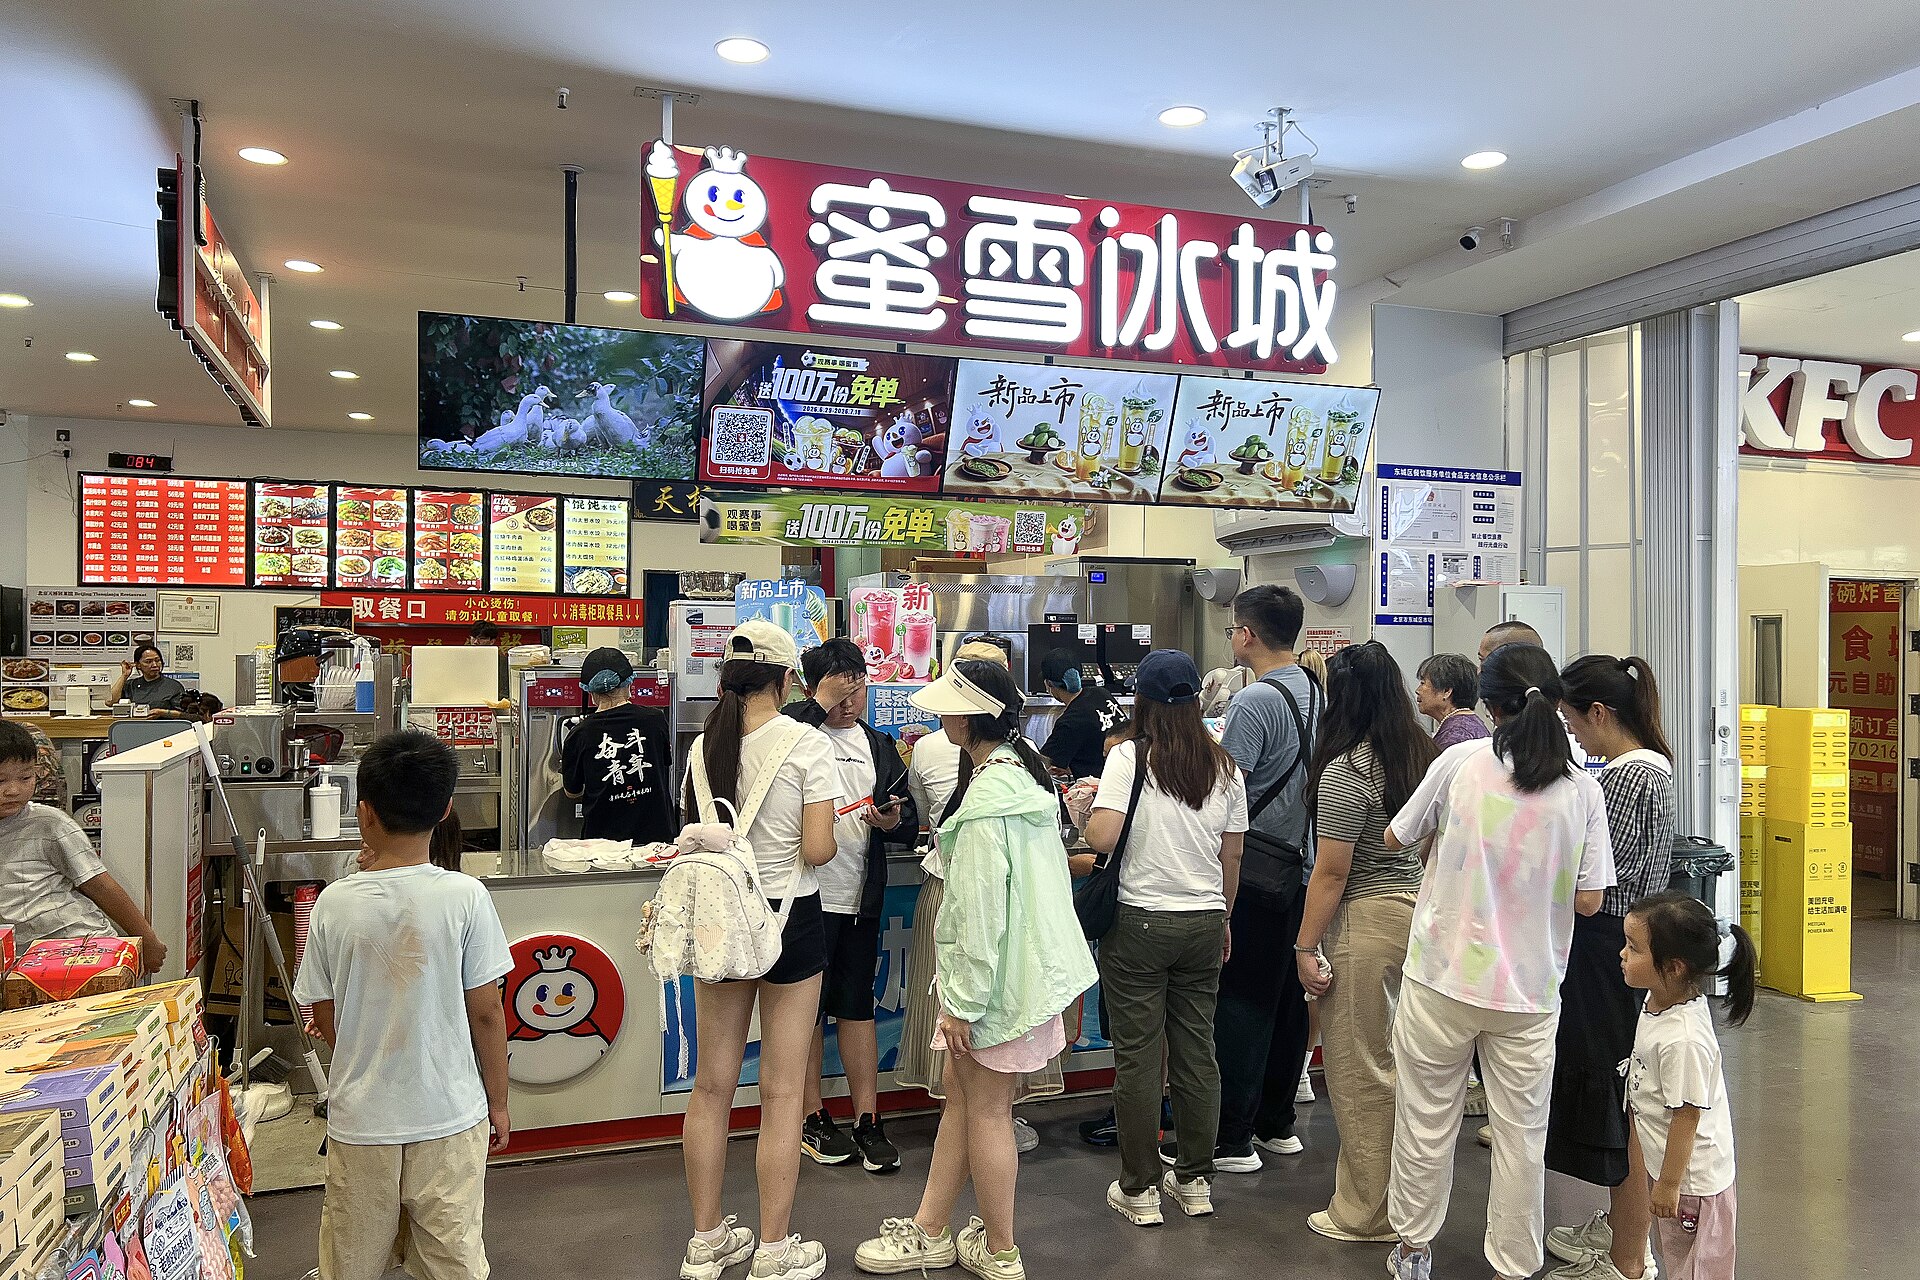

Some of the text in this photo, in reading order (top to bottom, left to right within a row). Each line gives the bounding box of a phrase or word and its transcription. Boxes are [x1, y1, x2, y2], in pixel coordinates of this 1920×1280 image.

[808, 177, 1339, 364] 蜜雪冰城
[757, 366, 903, 408] 送100万份免单
[977, 373, 1084, 425] 新品上市
[1738, 354, 1918, 459] KFC
[1197, 388, 1294, 436] 新品上市
[127, 456, 154, 468] 084
[719, 465, 759, 477] 扫码抢免单
[1393, 467, 1507, 483] 东城区餐饮服务单位食品安全信息公示栏
[727, 509, 762, 520] 观赛事
[727, 520, 762, 532] 喝蜜雪
[785, 504, 936, 544] 送100万份免单
[741, 580, 806, 601] 新品上市
[902, 582, 931, 611] 新
[352, 596, 426, 619] 取餐口
[570, 603, 624, 622] 消毒柜取餐具
[1829, 671, 1896, 696] 元自助
[875, 689, 912, 708] 果茶
[594, 727, 647, 760] 奋斗
[602, 754, 653, 786] 青年
[1808, 897, 1834, 906] 美团充电
[1808, 906, 1848, 915] 给生活加满电
